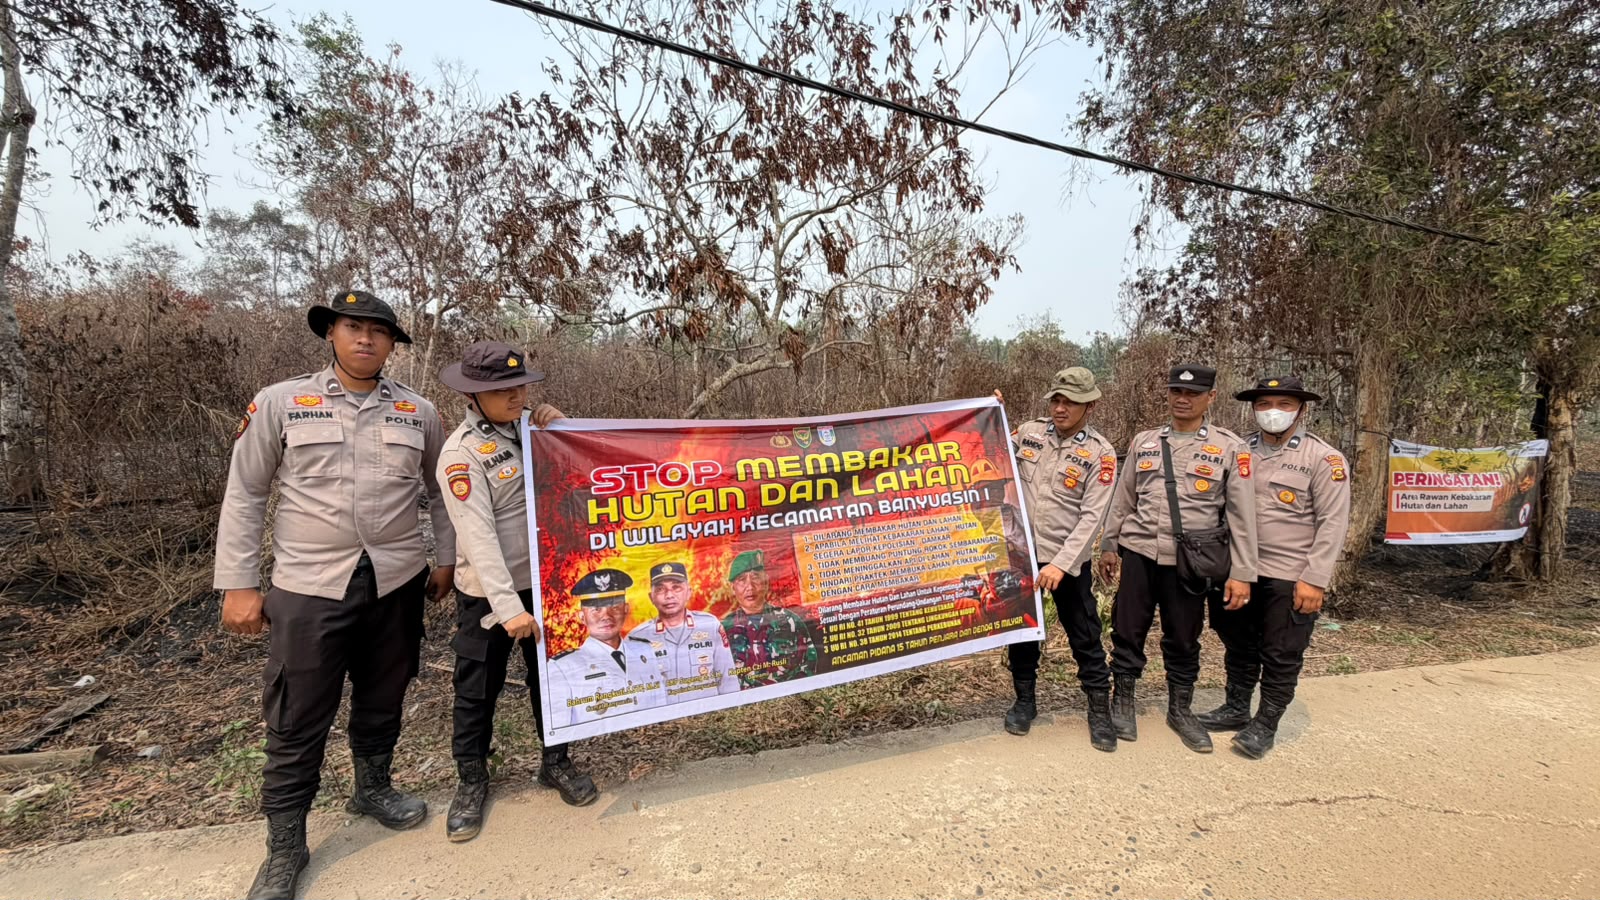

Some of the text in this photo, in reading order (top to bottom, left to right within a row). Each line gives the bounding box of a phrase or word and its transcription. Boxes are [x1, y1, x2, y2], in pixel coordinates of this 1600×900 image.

[288, 410, 333, 421] FARHAN
[385, 416, 423, 428] POLRI
[482, 449, 514, 470] ILHAM
[591, 441, 962, 494] STOP MEMBAKAR
[1064, 453, 1093, 470] POLRI
[1193, 453, 1224, 465] POLRI
[1281, 463, 1311, 474] POLRI
[1392, 472, 1502, 487] PERINGATAN!
[588, 464, 971, 524] HUTAN DAN LAHAN
[1401, 493, 1418, 501] Area
[1452, 493, 1492, 501] Kebakaran
[1401, 502, 1468, 510] Hutan dan Lahan
[589, 488, 990, 550] DI WILAYAH KECAMATAN BANYUASIN I
[813, 530, 852, 541] DILARANG
[854, 525, 896, 535] MEMBAKAR
[899, 521, 921, 529] HUTAN
[939, 515, 962, 524] LAHAN
[813, 534, 950, 560] SEGERA LAPOR KEPOLISIAN DAMKAR
[814, 541, 847, 551] APABILA
[848, 537, 880, 546] MELIHAT
[883, 530, 924, 540] KEBAKARAN
[926, 526, 949, 534] LAHAN
[955, 522, 977, 530] HUTAN
[817, 559, 840, 569] TIDAK
[842, 553, 886, 565] MEMBUANG
[888, 547, 922, 558] PUNTUNG
[924, 543, 947, 552] ROKOK
[949, 536, 998, 548] SEMBARANGAN
[819, 569, 841, 578] TIDAK
[843, 560, 902, 574] MENINGGALKAN
[927, 552, 949, 561] LAHAN
[956, 547, 978, 555] HUTAN
[819, 577, 852, 588] HINDARI
[854, 572, 887, 583] PRAKTEK
[889, 564, 925, 575] MEMBUKA
[927, 561, 950, 570] LAHAN
[952, 553, 996, 565] PERKEBUNAN
[820, 576, 919, 598] DENGAN CARA MEMBAKAR
[818, 604, 842, 614] Dilarang
[843, 599, 870, 609] Membakar
[872, 596, 888, 604] Hutan
[900, 589, 916, 598] Lahan
[917, 586, 933, 595] Untuk
[820, 615, 838, 624] Sesuai
[838, 611, 860, 622] Dengan
[860, 606, 887, 617] Peraturan
[943, 593, 955, 602] Yang
[829, 634, 838, 642] UU
[839, 632, 846, 640] RI
[857, 629, 865, 637] 32
[866, 625, 885, 635] TAHUN
[901, 617, 925, 627] TENTANG
[839, 623, 846, 631] RI
[864, 617, 883, 626] TAHUN
[899, 608, 923, 618] TENTANG
[688, 641, 713, 650] POLRI
[830, 644, 839, 652] UU
[869, 634, 888, 643] TAHUN
[888, 631, 902, 640] 2014
[902, 626, 926, 636] TENTANG
[927, 619, 962, 632] PERKEBUNAN
[831, 616, 1024, 666] ANCAMAN PIDANA 15 TAHUN PENJARA DAN DENDA 15 MILYAR
[771, 658, 787, 666] Rusli
[567, 695, 594, 707] Bahrum
